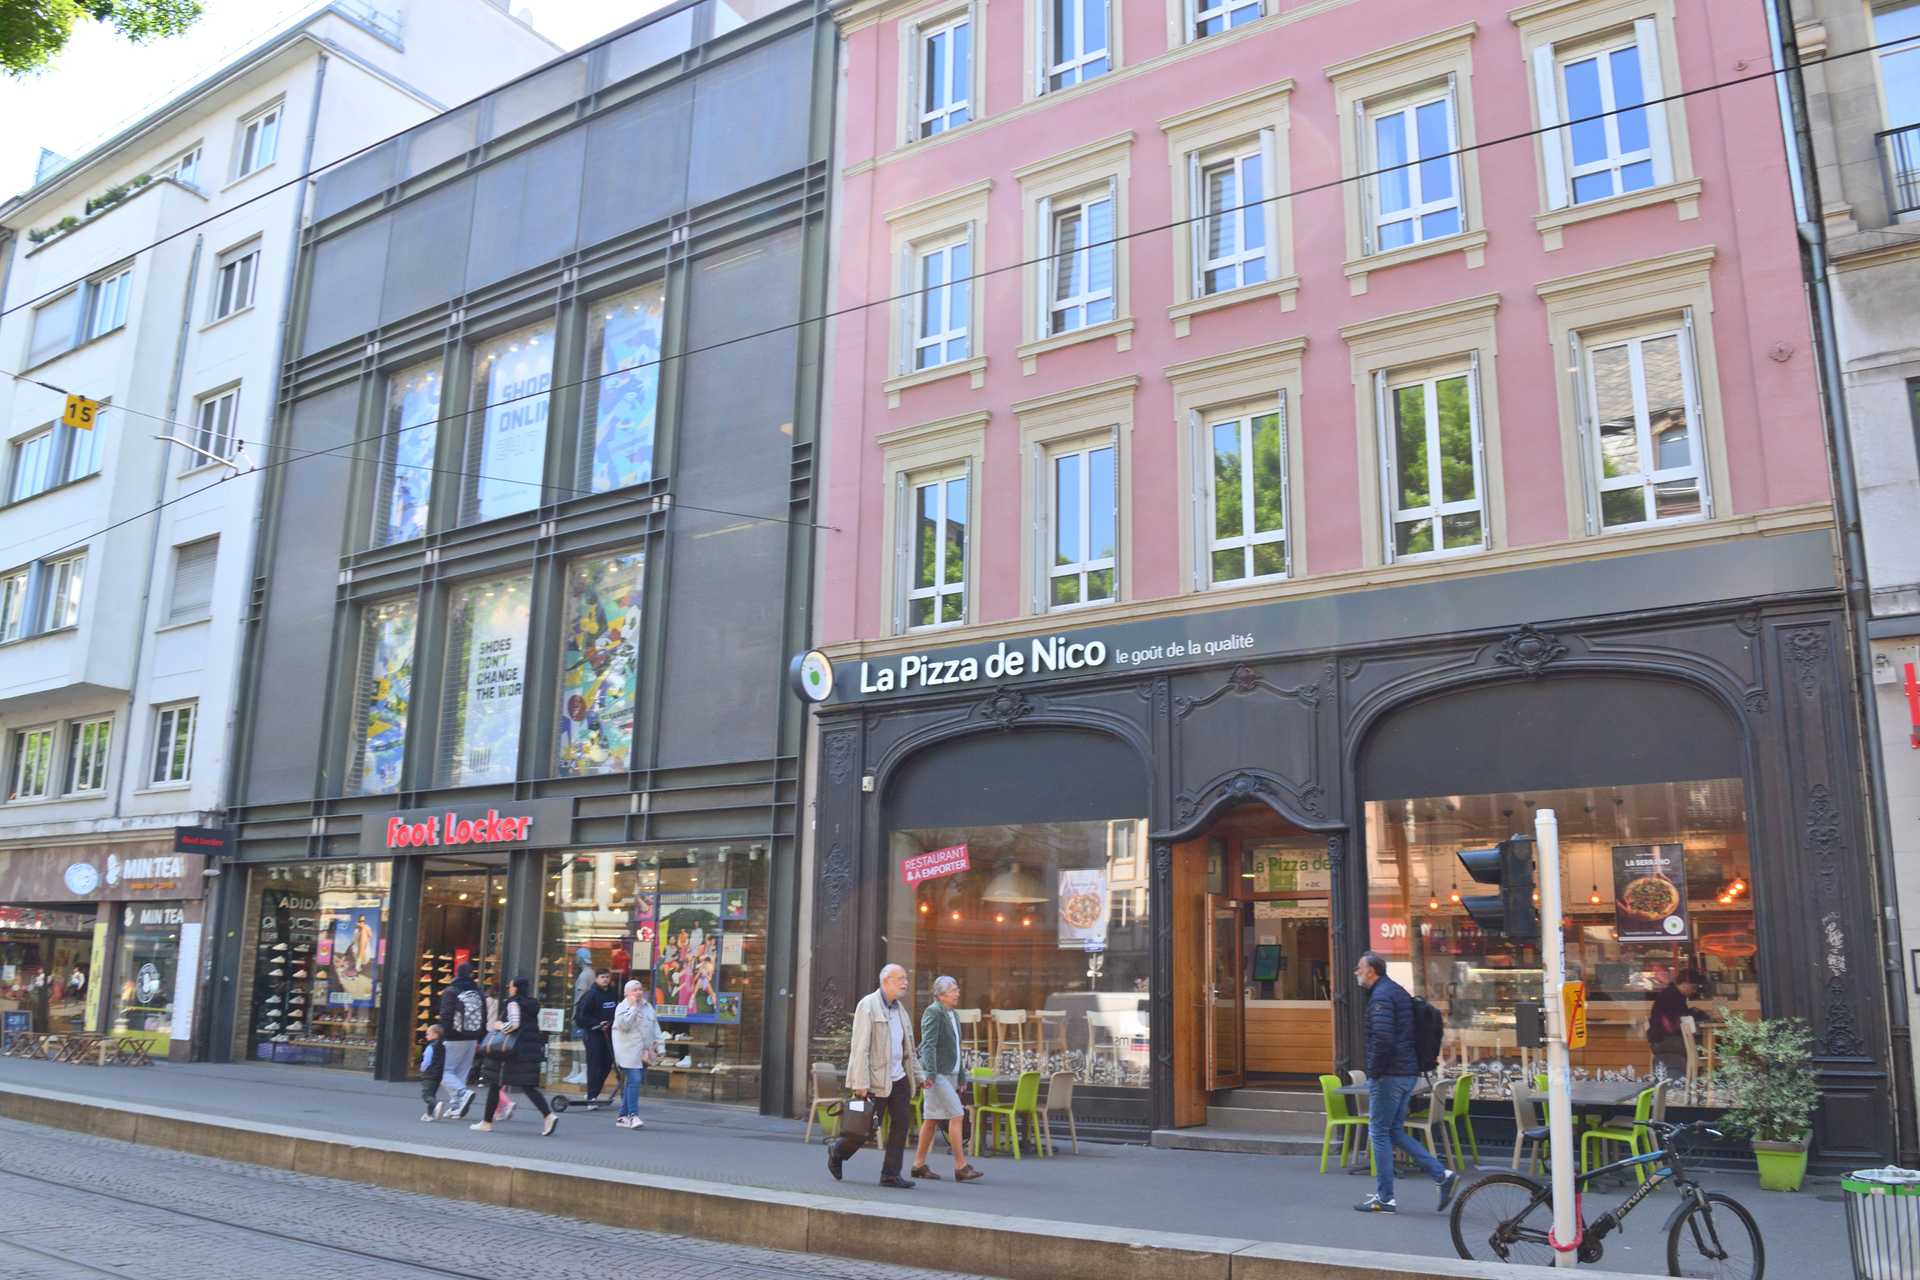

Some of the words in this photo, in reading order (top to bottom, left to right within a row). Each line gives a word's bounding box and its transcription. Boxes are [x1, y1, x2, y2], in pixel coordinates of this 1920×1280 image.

[503, 372, 550, 400] SHOP
[69, 403, 91, 423] 15
[479, 638, 512, 655] SHOES
[1115, 649, 1129, 664] le
[1131, 645, 1163, 665] goût
[1166, 641, 1185, 658] de
[1188, 639, 1201, 655] la
[1204, 633, 1255, 656] qualité
[478, 653, 509, 669] DON'T
[860, 662, 895, 693] La
[900, 654, 978, 689] Pizza
[985, 640, 1025, 678] de
[1031, 635, 1107, 673] Nico
[476, 667, 519, 685] CHANGE
[476, 686, 495, 700] THE
[386, 815, 440, 848] Foot
[443, 808, 533, 845] Locker
[904, 846, 966, 871] RESTAURANT
